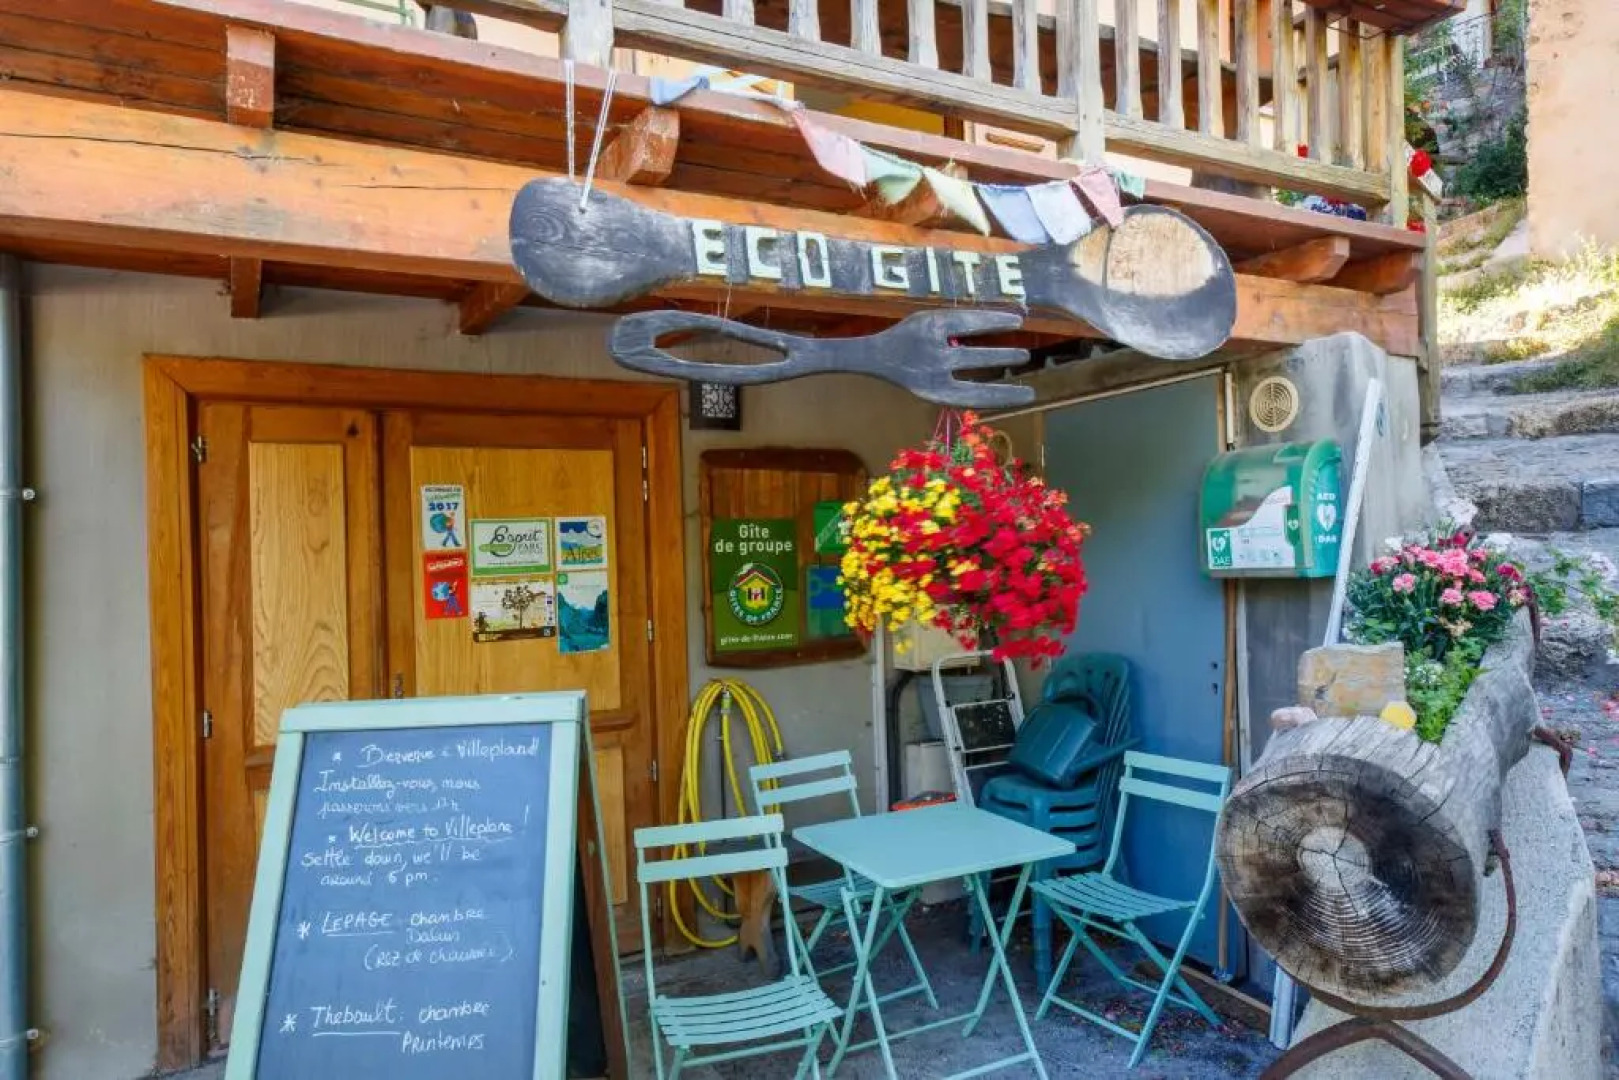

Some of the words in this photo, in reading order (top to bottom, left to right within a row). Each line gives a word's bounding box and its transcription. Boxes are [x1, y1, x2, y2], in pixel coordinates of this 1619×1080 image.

[692, 218, 831, 288] ECO
[870, 246, 1026, 296] GITE
[428, 502, 459, 512] 2017
[739, 523, 770, 538] Gîte
[715, 539, 734, 553] de
[740, 542, 793, 555] groupe
[349, 822, 415, 843] Welcome
[423, 826, 439, 838] to
[300, 849, 353, 868] Settle
[461, 848, 481, 862] be
[320, 870, 373, 886] around
[388, 869, 398, 884] 6
[321, 911, 394, 934] LEPAGE
